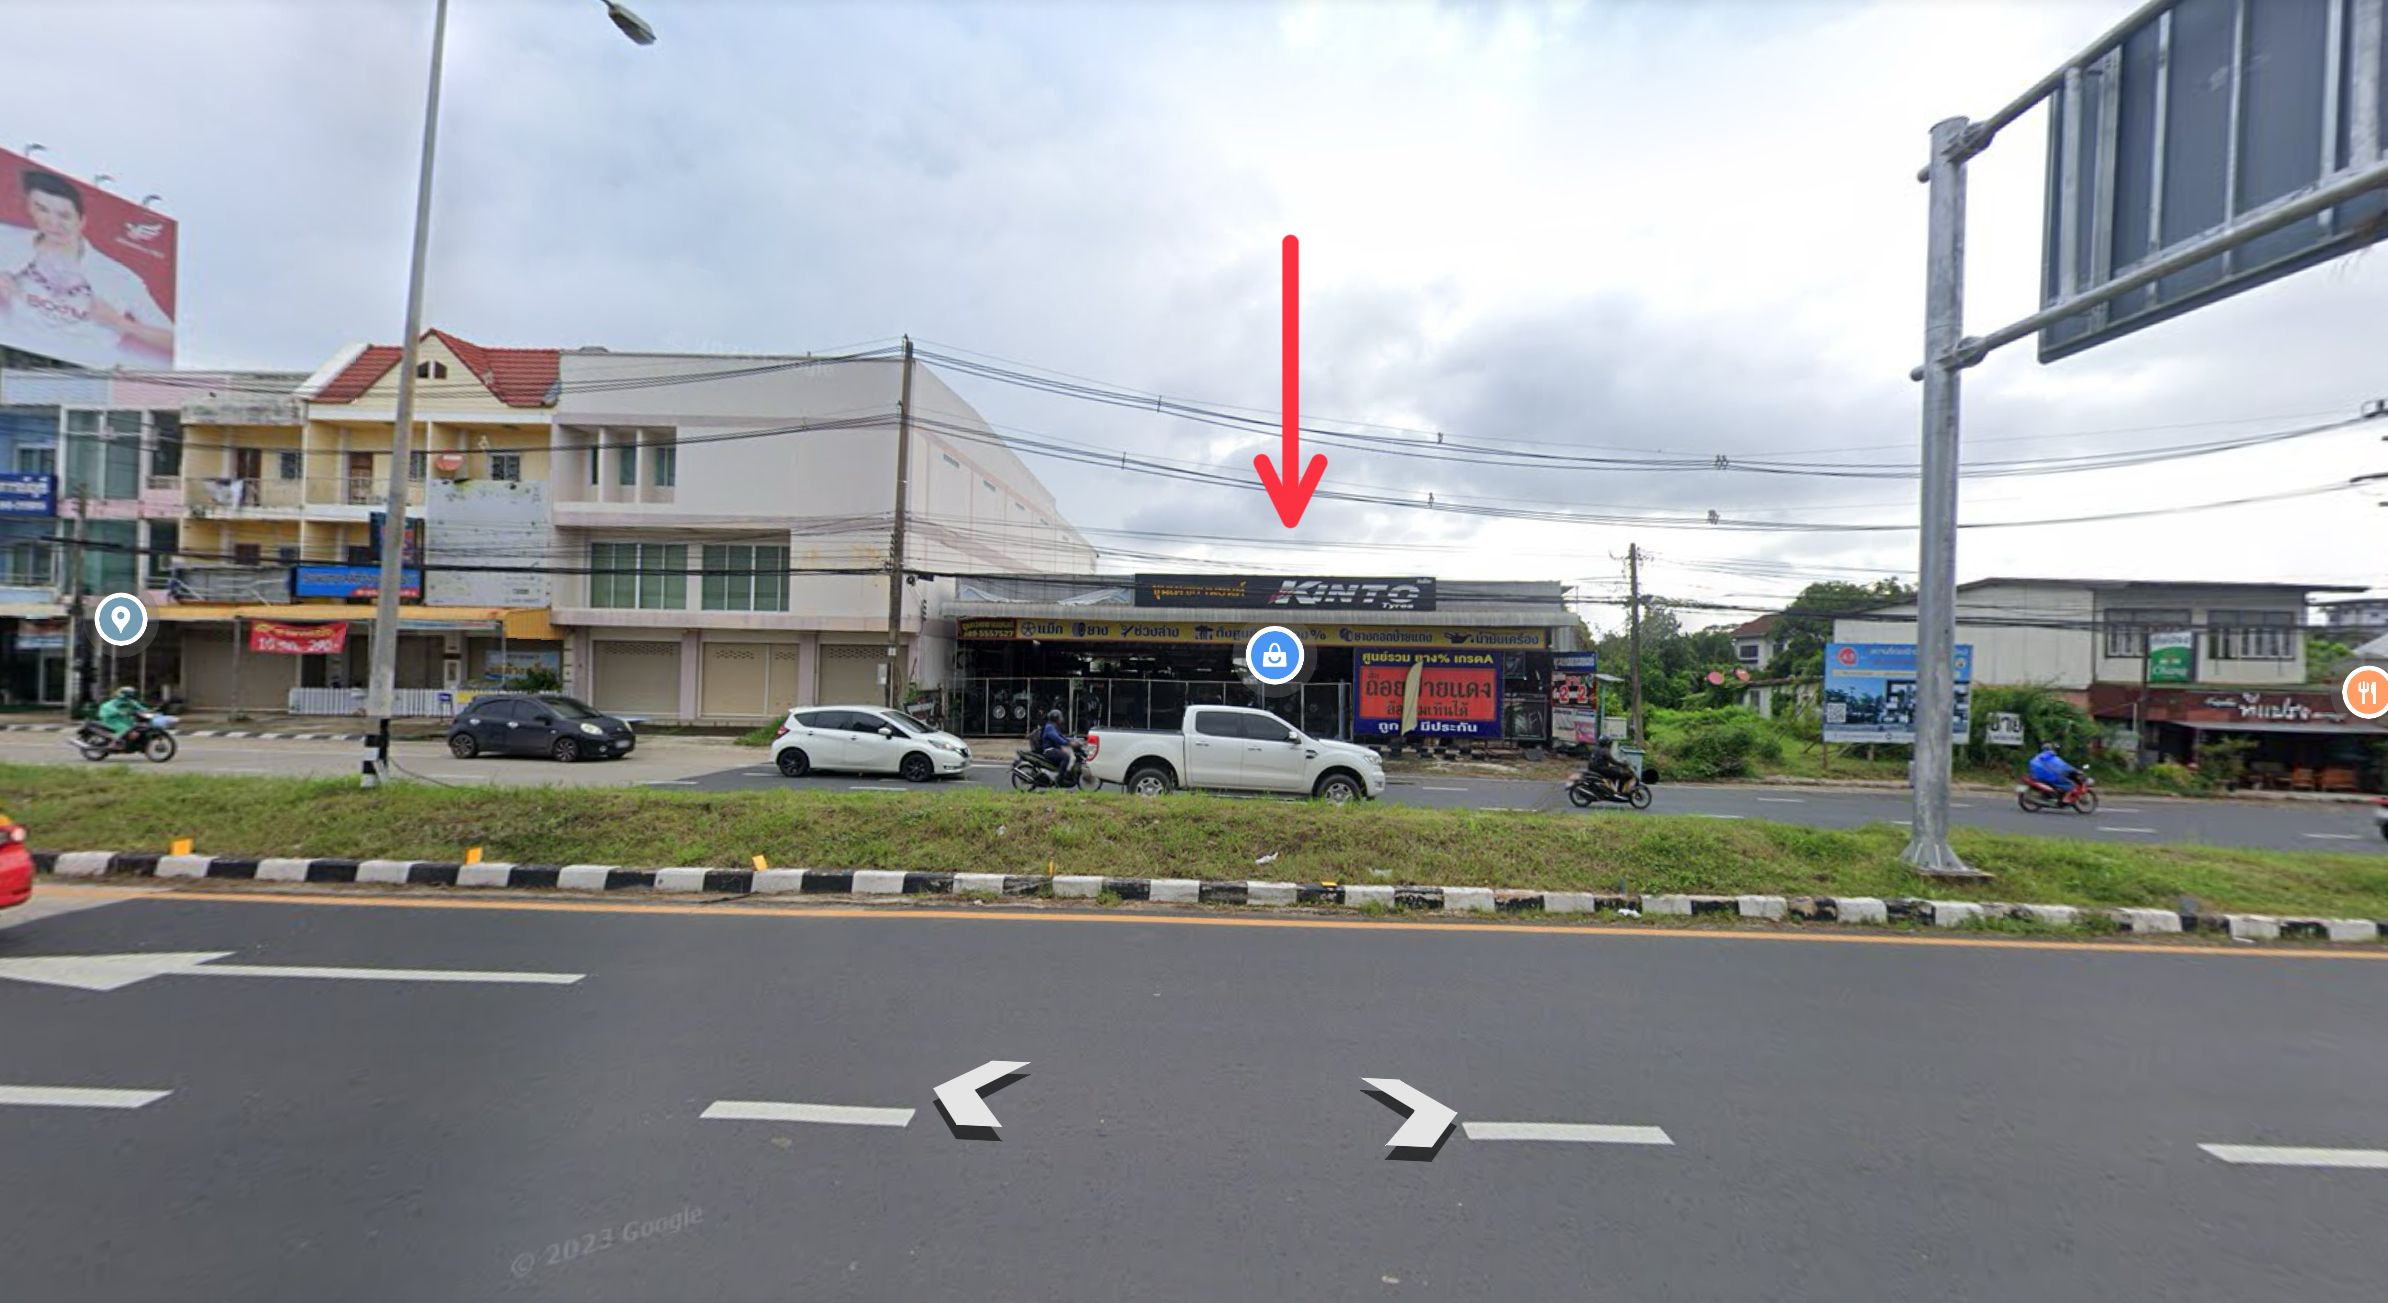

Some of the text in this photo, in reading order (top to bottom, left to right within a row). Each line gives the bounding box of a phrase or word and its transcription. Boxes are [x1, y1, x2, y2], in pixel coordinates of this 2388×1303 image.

[1271, 579, 1420, 605] KINTO
[1087, 624, 1109, 636] ยาง
[1361, 651, 1410, 665] ศูนย์รวม
[1420, 720, 1479, 734] มีประกัน
